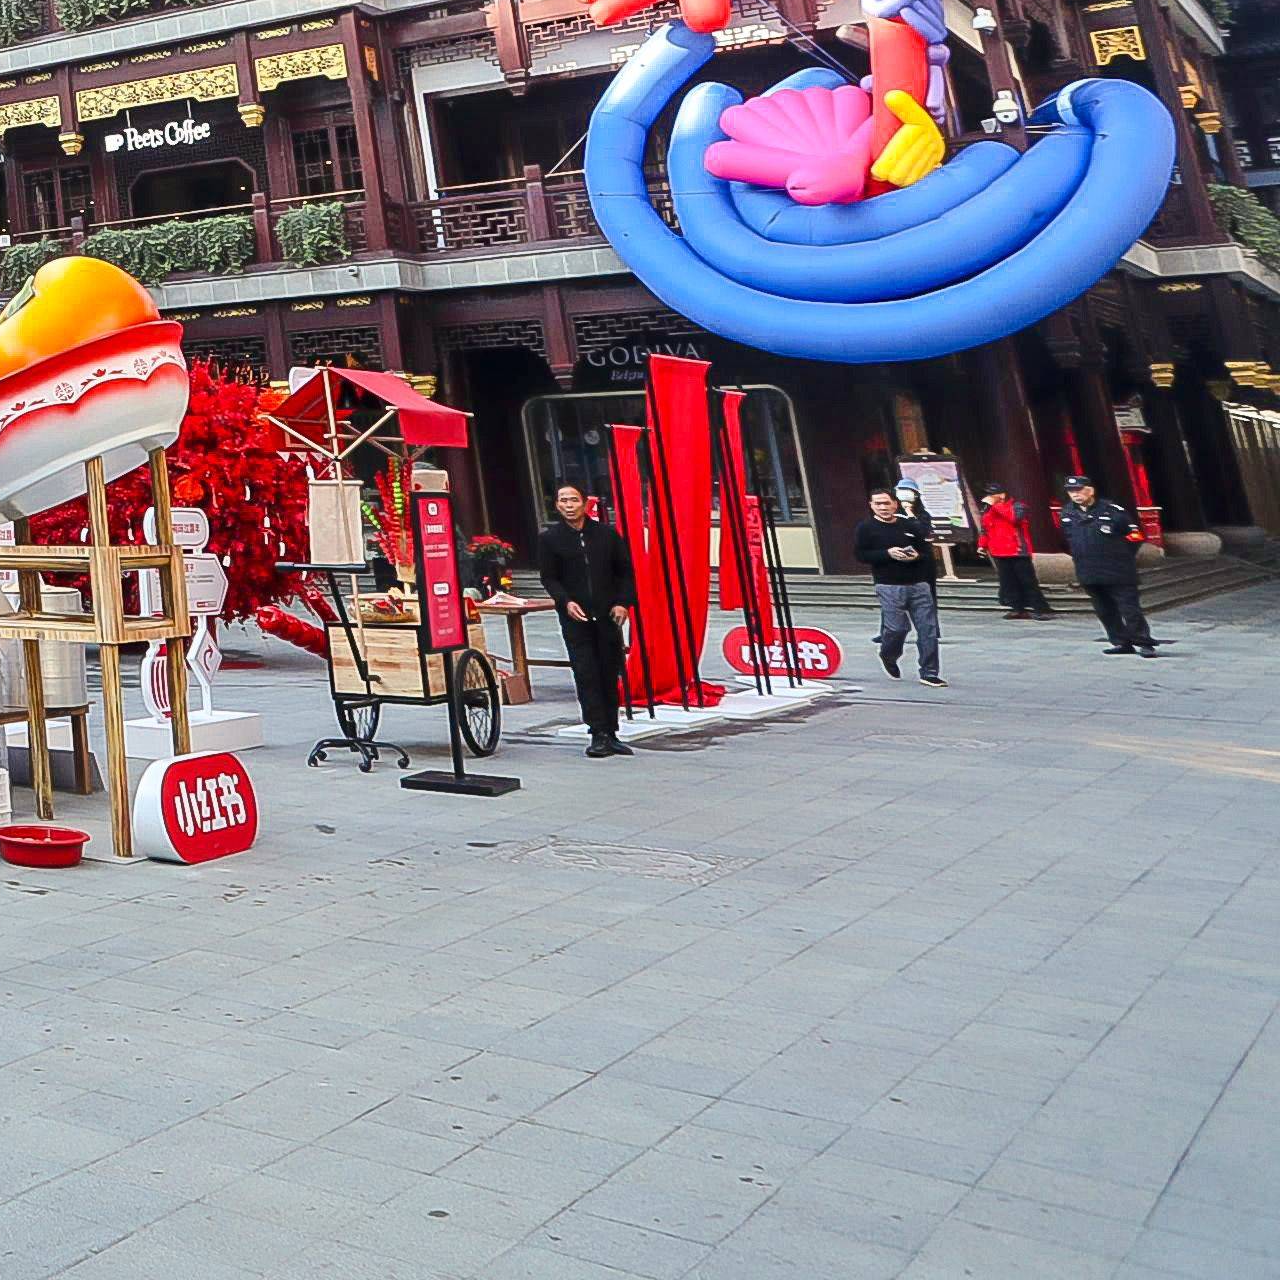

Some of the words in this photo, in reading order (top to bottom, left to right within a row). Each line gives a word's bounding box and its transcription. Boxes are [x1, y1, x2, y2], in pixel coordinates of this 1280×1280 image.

[164, 119, 211, 147] Coffee
[741, 639, 829, 670] 小红书
[174, 772, 247, 837] 小红书
